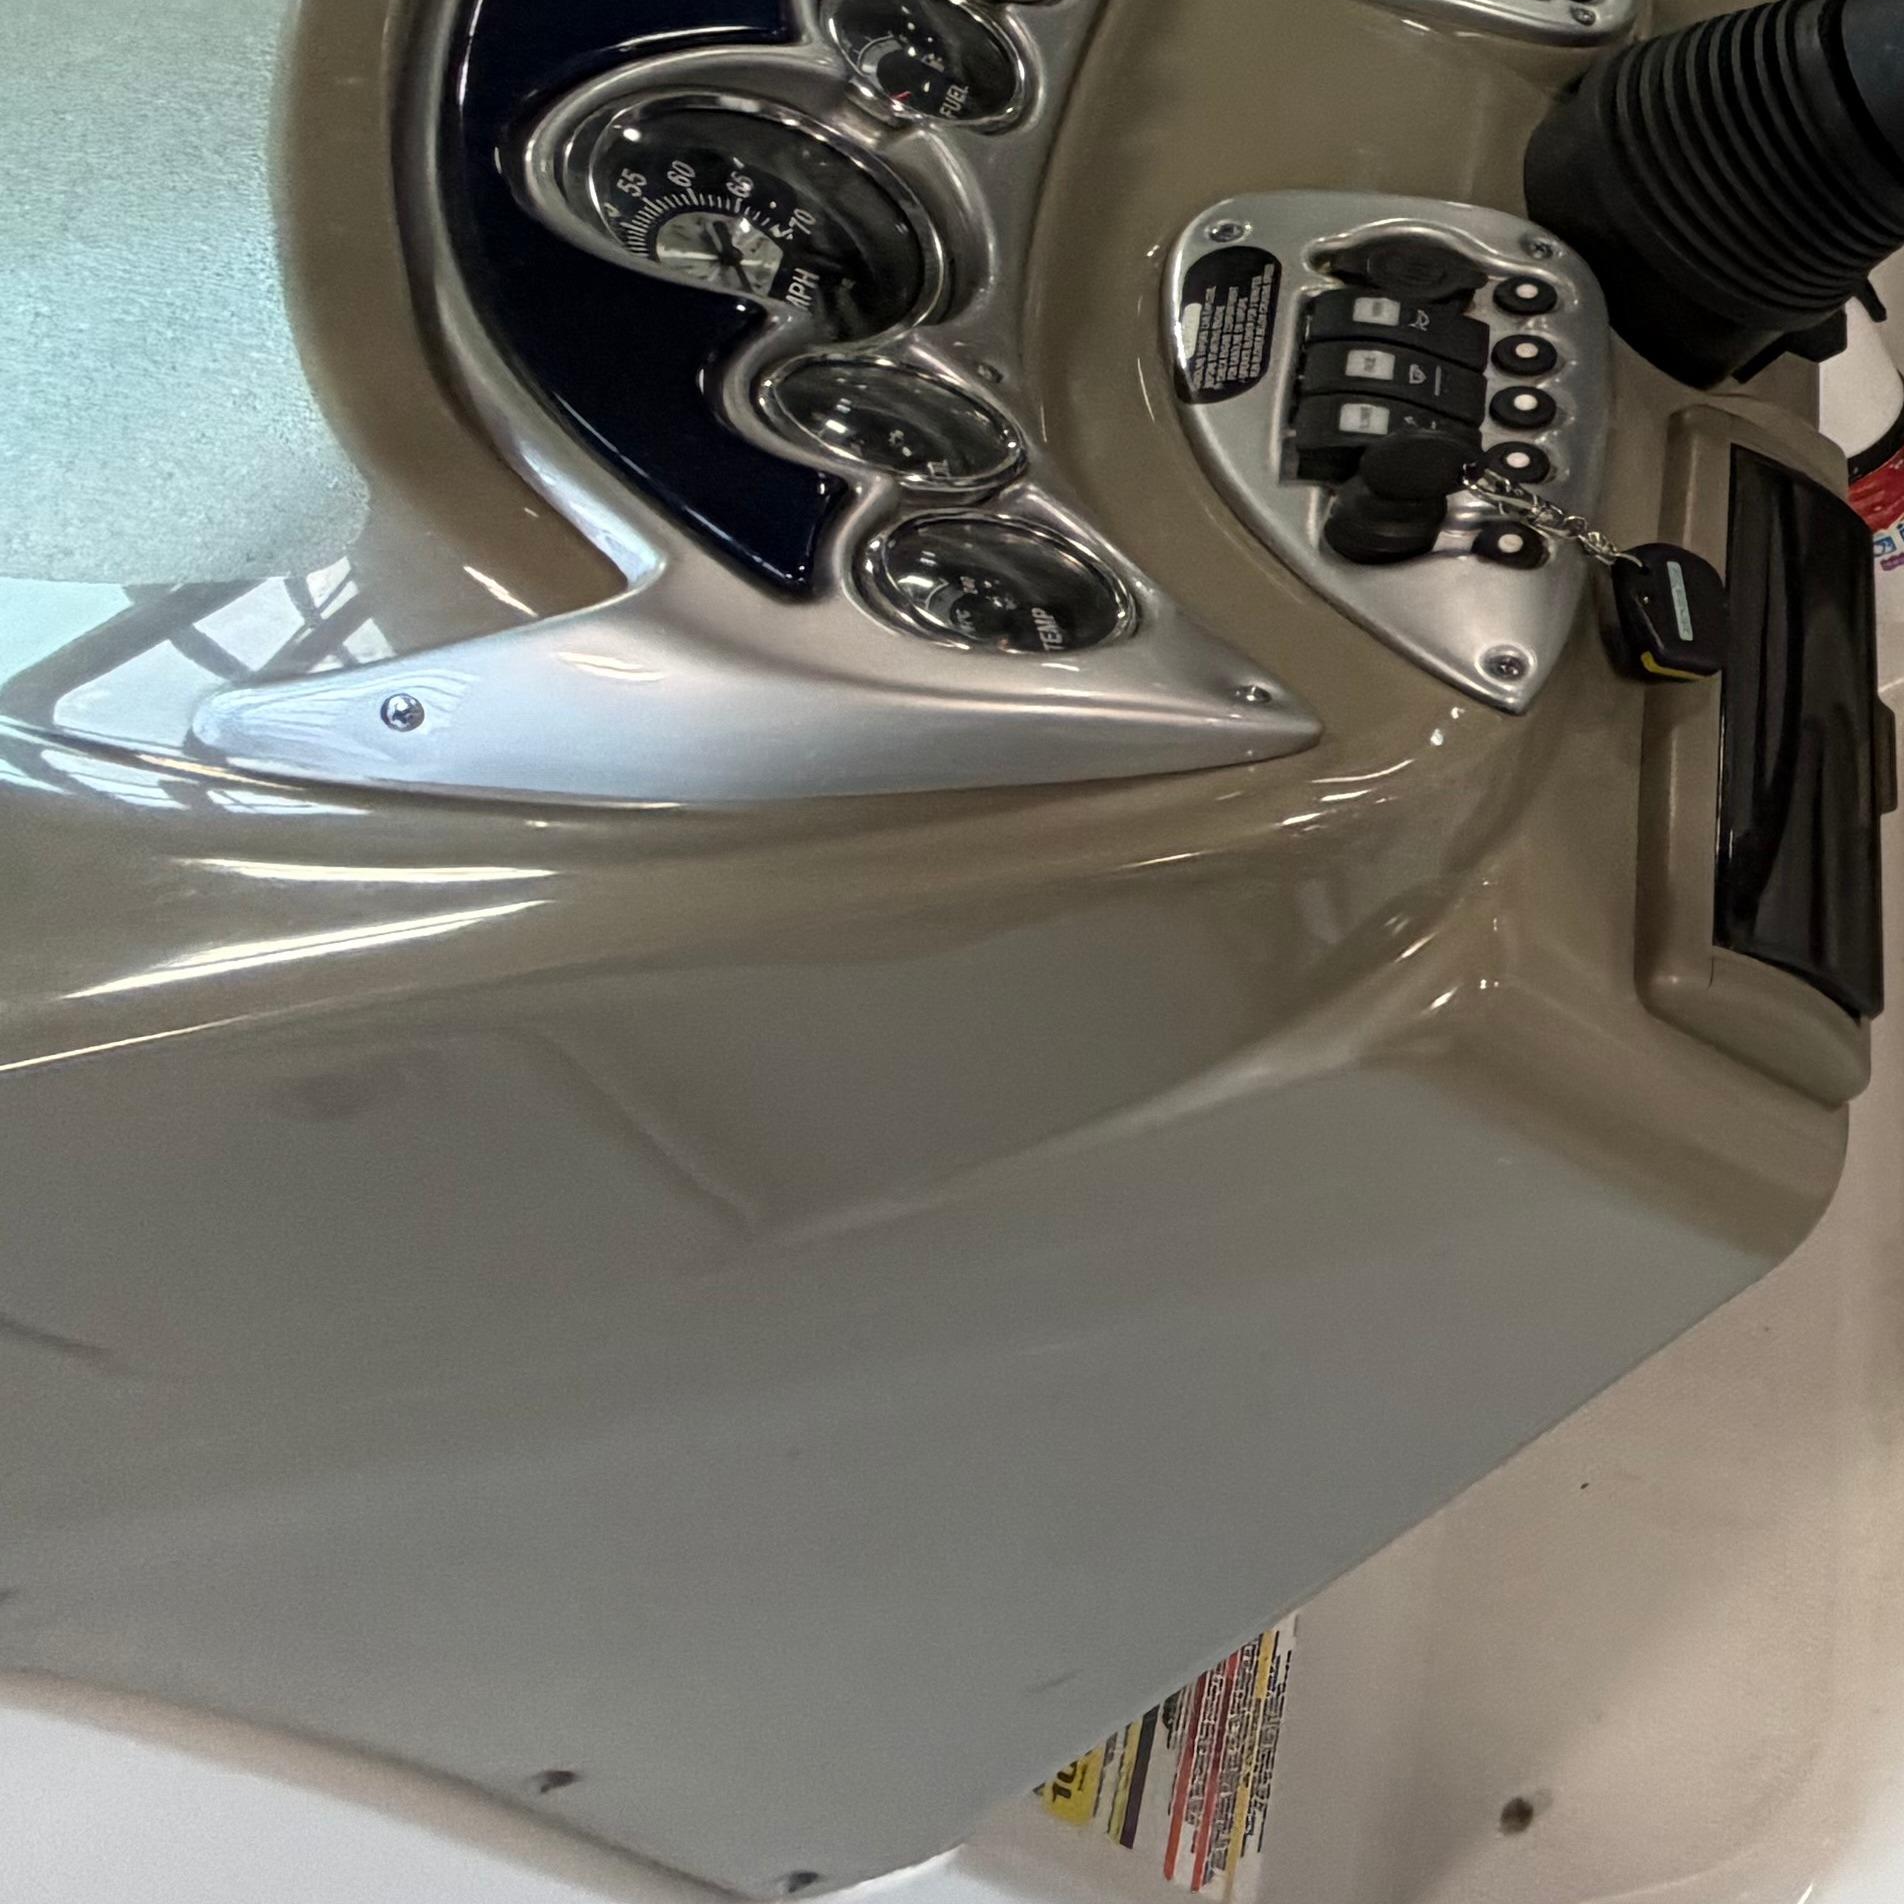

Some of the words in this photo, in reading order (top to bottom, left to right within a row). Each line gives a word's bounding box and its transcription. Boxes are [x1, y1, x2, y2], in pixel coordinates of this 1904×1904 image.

[939, 84, 969, 120] FUEL
[616, 167, 648, 198] 55
[666, 160, 697, 188] 60
[788, 207, 818, 236] 70
[1031, 606, 1066, 652] TEMP
